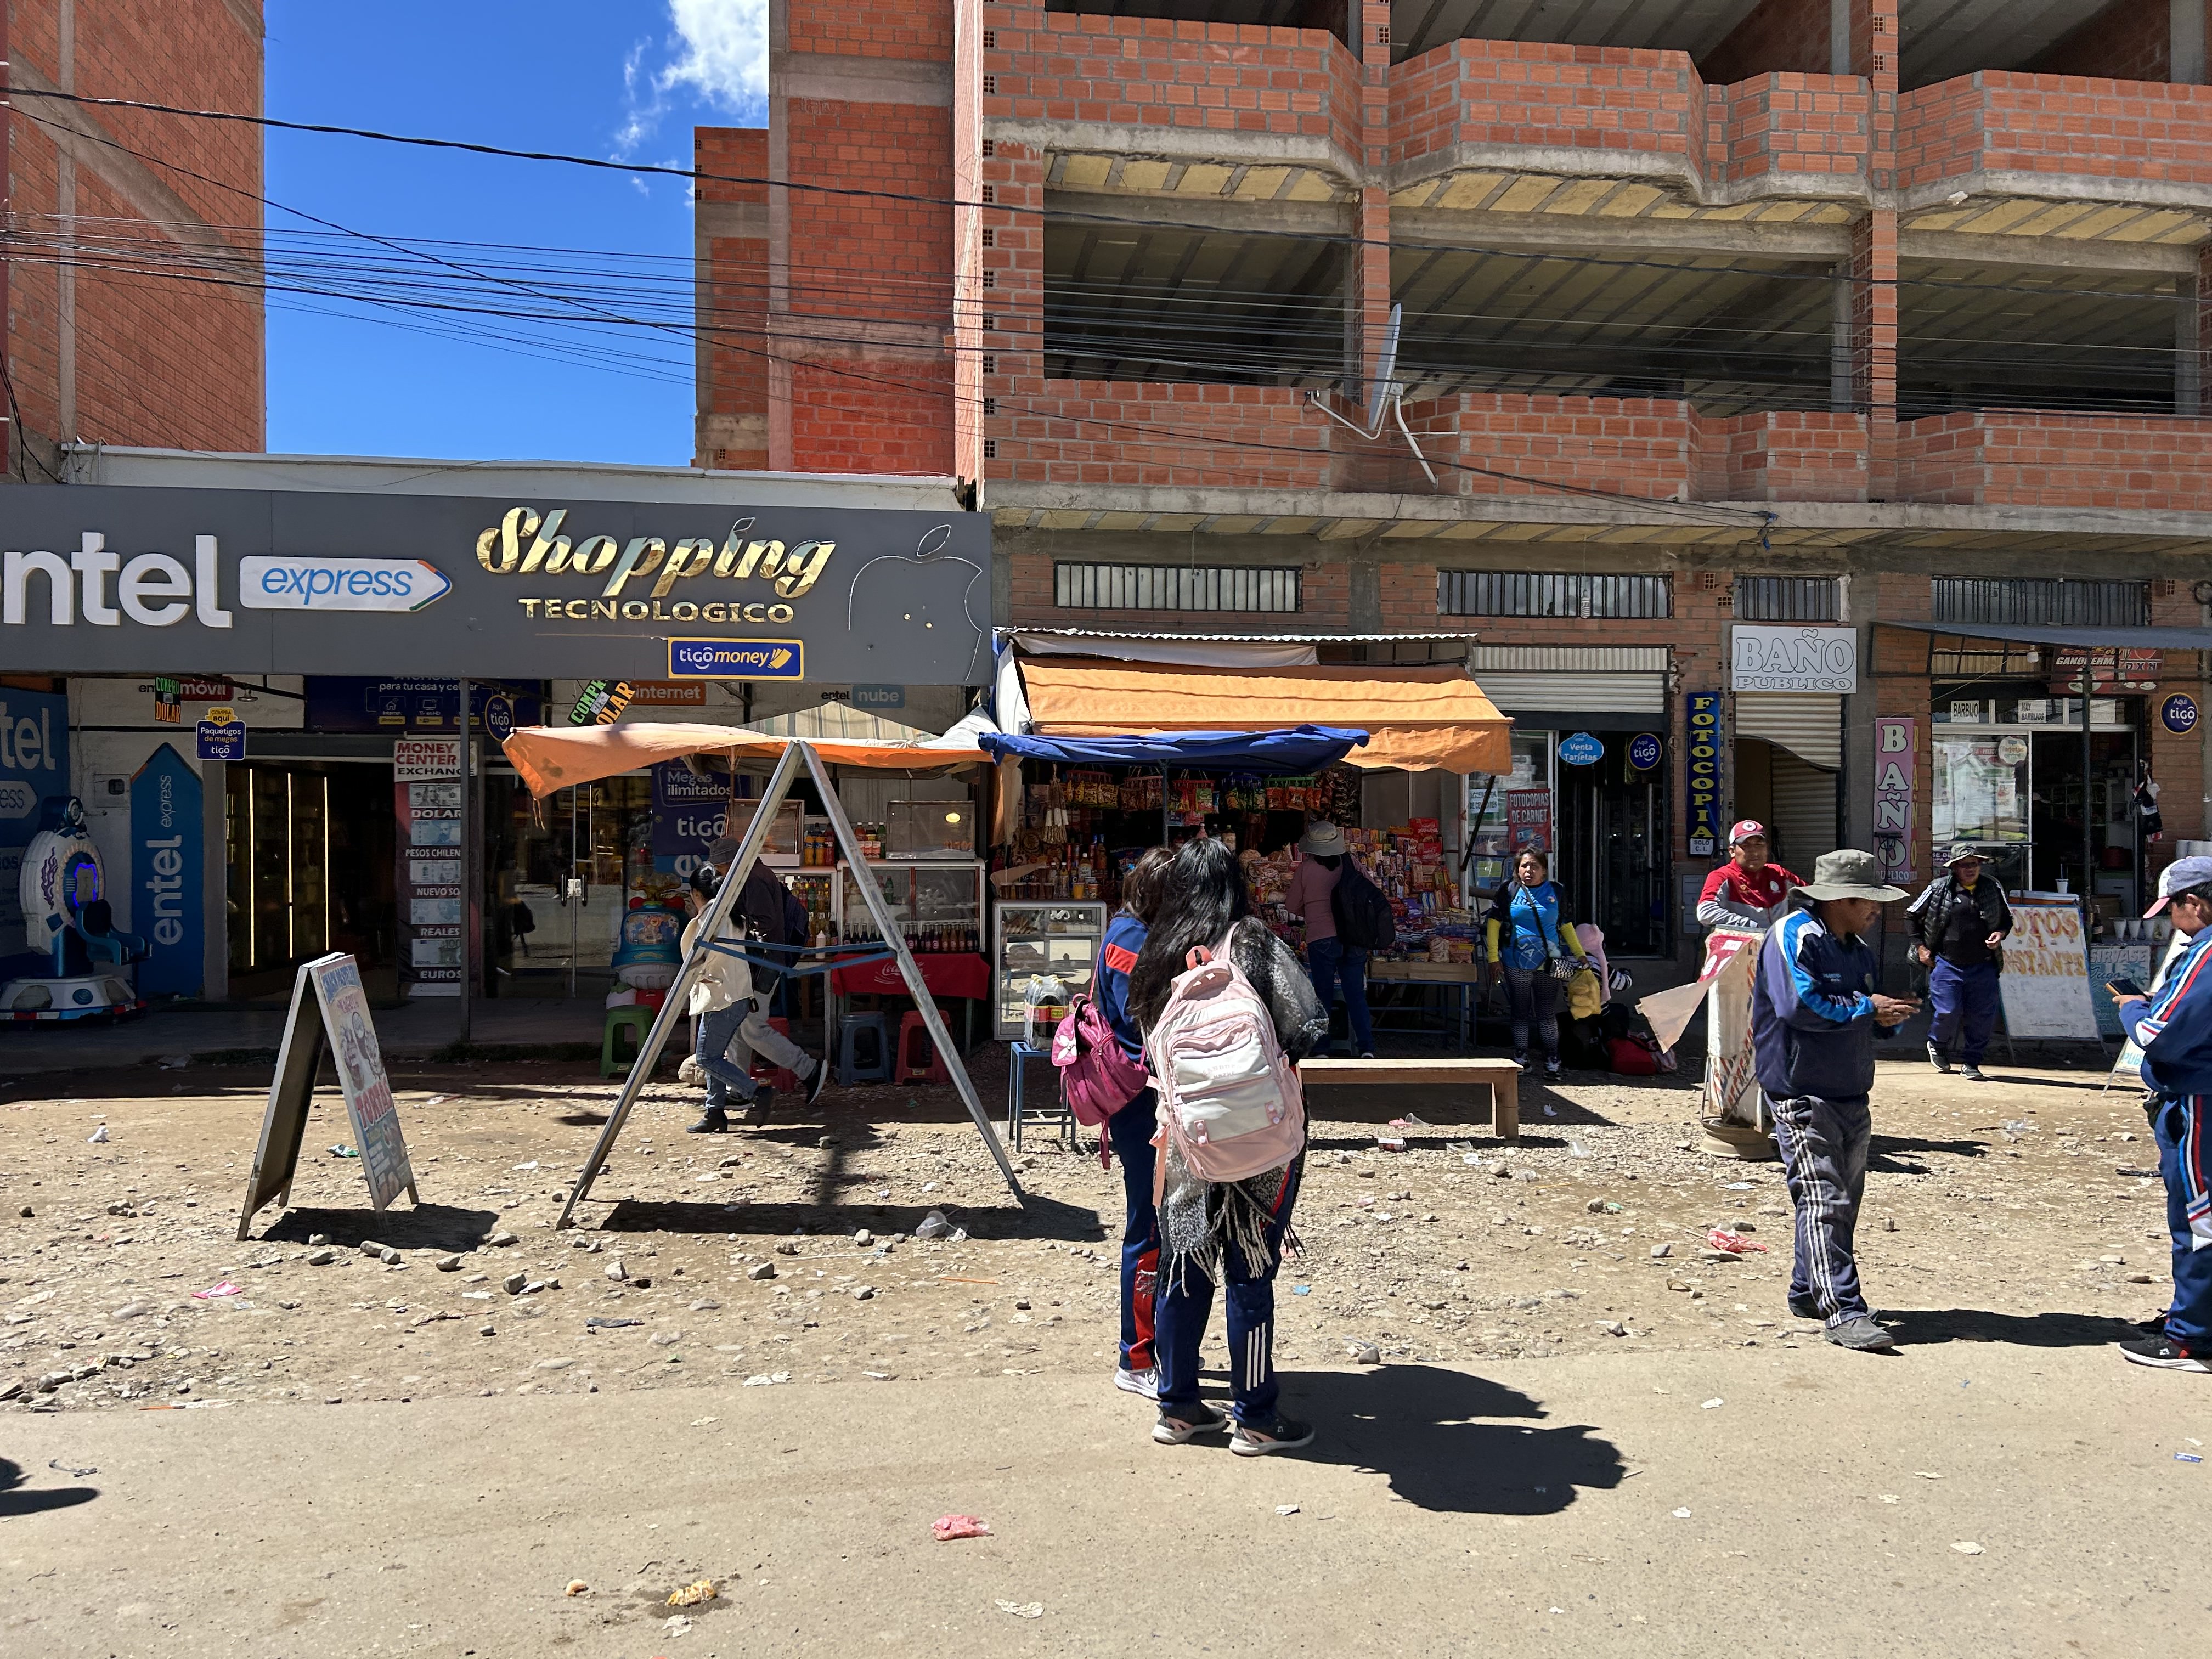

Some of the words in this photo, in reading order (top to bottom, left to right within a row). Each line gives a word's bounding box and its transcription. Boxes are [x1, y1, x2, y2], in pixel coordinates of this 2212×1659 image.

[476, 506, 836, 599] Shopping
[0, 532, 233, 628] ntel
[262, 567, 413, 605] express
[518, 598, 794, 624] TECNOLOGICO
[1735, 628, 1854, 674] BAÑO
[2055, 657, 2115, 665] GANOERM
[156, 676, 180, 695] COMPRO
[379, 683, 401, 692] para
[439, 684, 445, 692] y
[1736, 676, 1853, 690] PUBLICO
[635, 686, 701, 700] internet
[821, 690, 850, 701] entel
[857, 688, 900, 703] nube
[570, 680, 607, 724] COMPR
[596, 682, 636, 725] OLAR
[156, 701, 181, 723] DOLAR
[200, 727, 241, 737] Paquetigos
[398, 743, 456, 753] MONEY
[396, 754, 457, 765] CENTER
[1564, 753, 1598, 763] Tarjetas
[1691, 697, 1716, 838] FOTOCOPIA
[668, 771, 712, 786] Megas
[668, 784, 731, 795] ilimitados
[1878, 724, 1910, 867] BAÑO
[160, 775, 176, 828] express
[1509, 792, 1549, 808] FOTOCOPIAS
[1511, 810, 1521, 823] DE
[1522, 809, 1548, 823] CARNET
[405, 849, 430, 857] PESOS
[432, 849, 461, 857] CHILEN
[1875, 870, 1909, 881] PULICO
[146, 835, 183, 945] entel
[417, 888, 447, 896] NUEVO
[449, 888, 461, 896] SO
[2010, 908, 2079, 938] OTOS
[420, 928, 461, 936] REALES
[2002, 949, 2087, 976] NSTANTE
[2090, 949, 2148, 963] SIRVASE
[420, 970, 461, 979] EUROS
